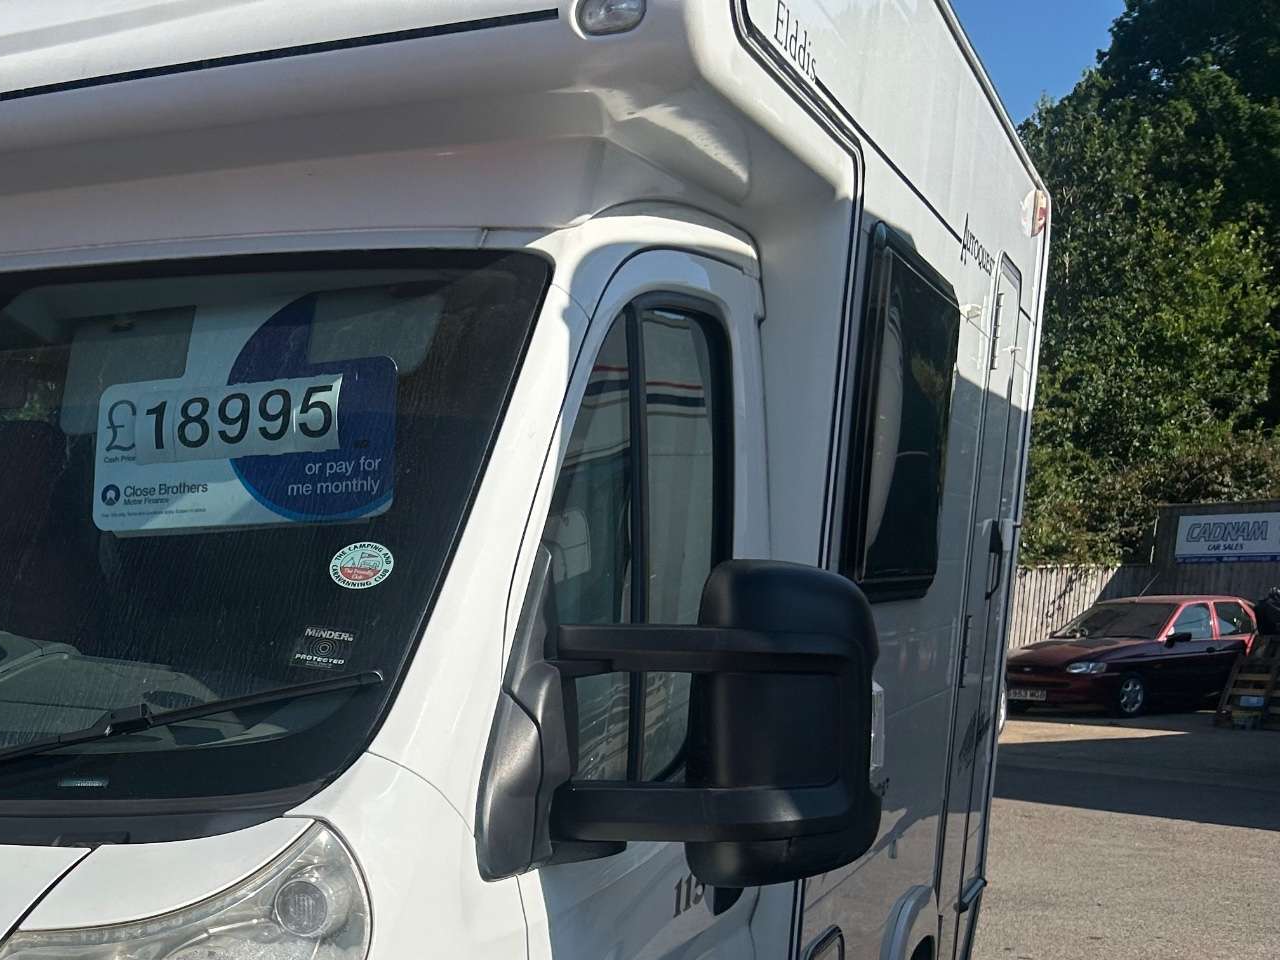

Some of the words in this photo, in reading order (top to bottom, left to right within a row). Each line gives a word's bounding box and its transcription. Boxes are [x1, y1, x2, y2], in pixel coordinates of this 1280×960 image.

[774, 1, 817, 82] Elddis
[960, 212, 996, 277] AUTOQUEST
[105, 384, 335, 452] £18995
[305, 463, 322, 475] or
[326, 461, 355, 477] pay
[360, 456, 381, 472] for
[123, 486, 156, 498] Close
[158, 482, 208, 496] Brothers
[288, 484, 312, 496] me
[317, 476, 380, 495] monthly
[1186, 520, 1268, 542] CADNAM
[335, 550, 347, 561] THE
[348, 543, 383, 552] CAMPING
[381, 552, 392, 565] AND
[332, 564, 372, 587] CARAVANNING
[374, 568, 390, 582] CLUB
[295, 653, 345, 665] PROTECTED
